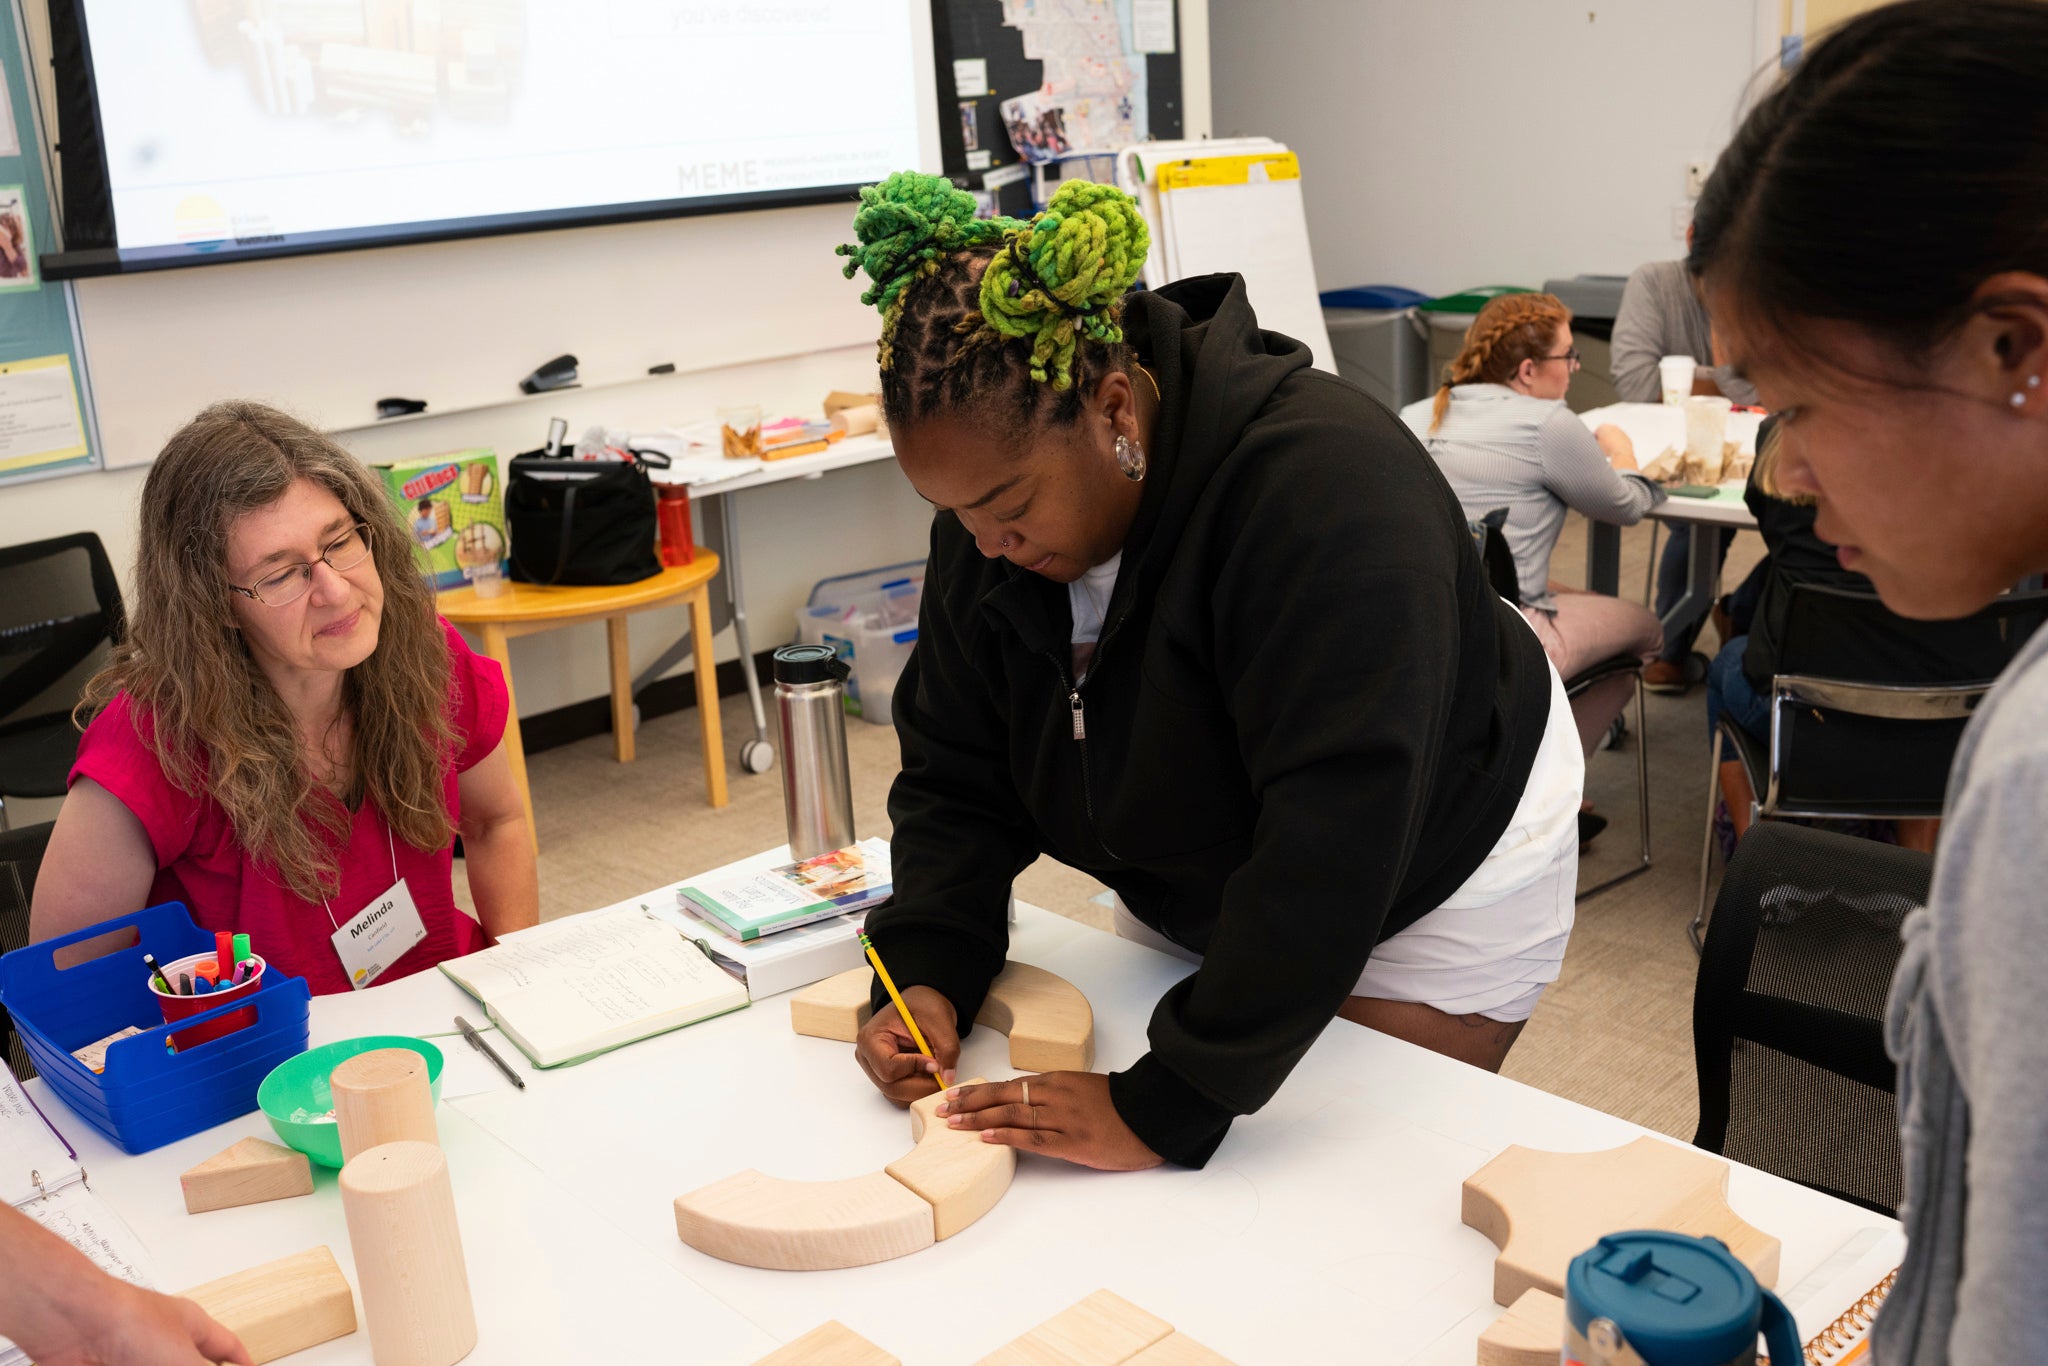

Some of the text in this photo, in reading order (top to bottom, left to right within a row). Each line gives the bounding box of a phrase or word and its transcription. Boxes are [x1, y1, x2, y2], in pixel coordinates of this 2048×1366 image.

[671, 2, 832, 32] you've discovered
[677, 160, 759, 192] MEME
[350, 901, 394, 939] Melinda
